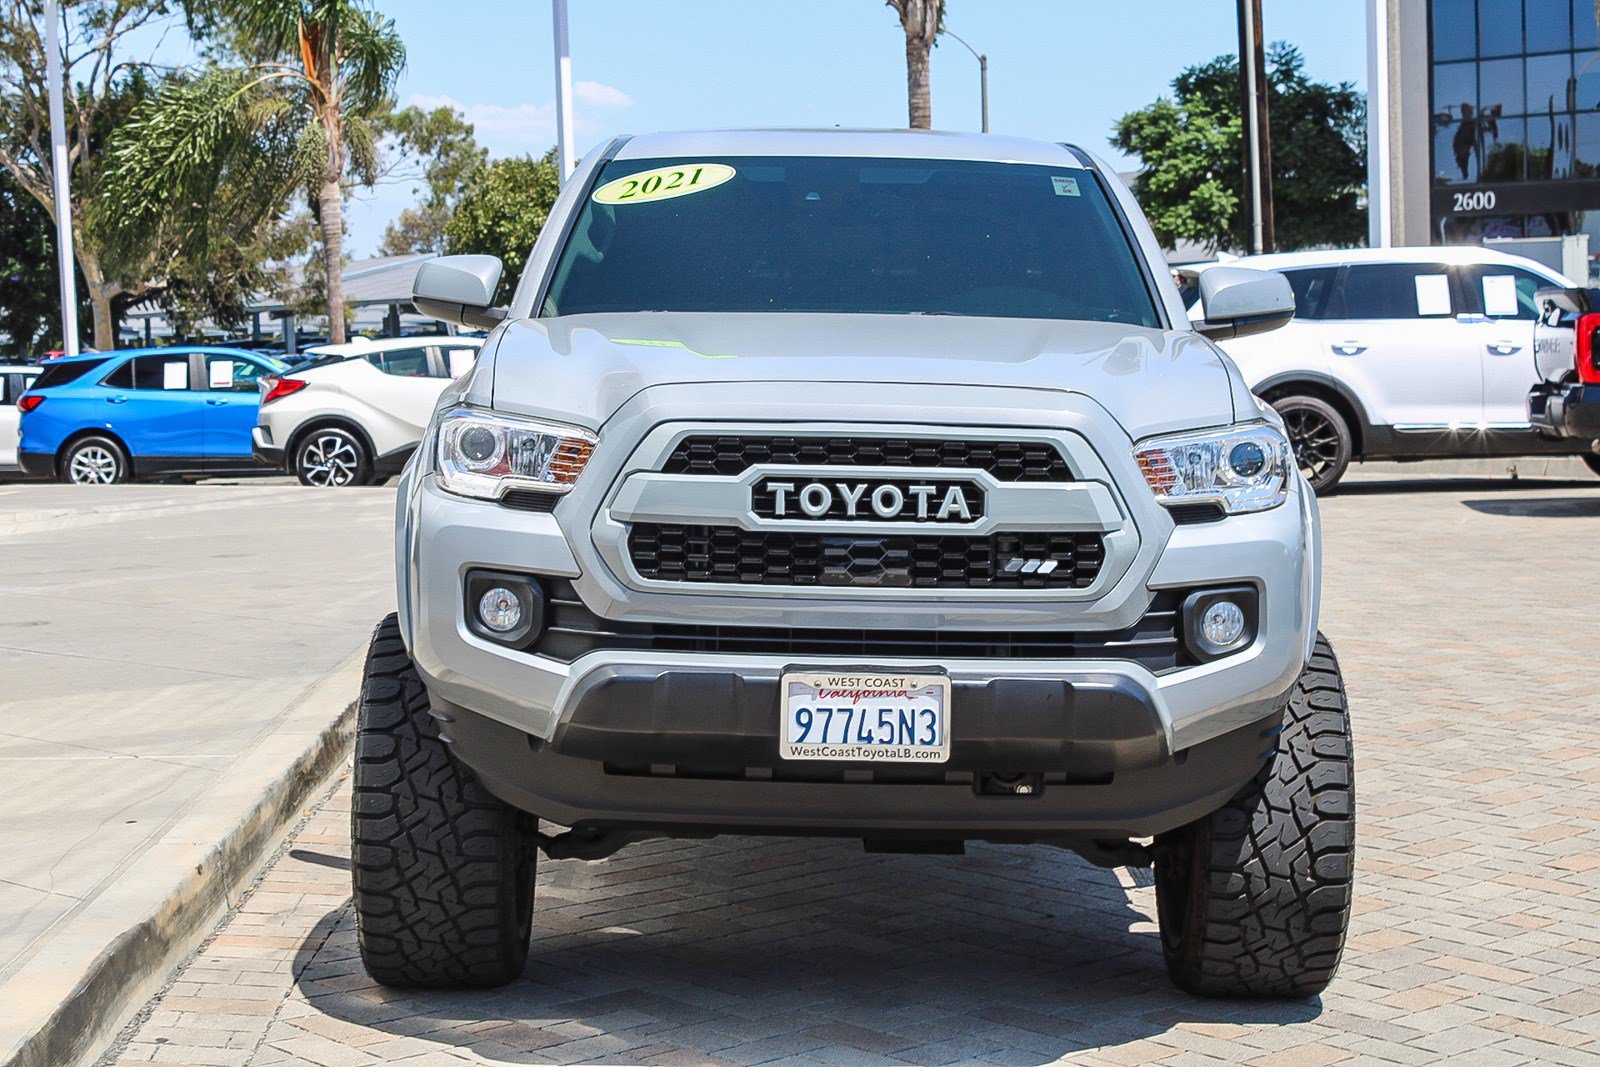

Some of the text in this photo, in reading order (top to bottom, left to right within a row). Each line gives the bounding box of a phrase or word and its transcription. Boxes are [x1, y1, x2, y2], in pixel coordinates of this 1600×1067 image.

[618, 168, 704, 200] 2021
[1453, 191, 1496, 211] 2600
[766, 482, 972, 520] TOYOTA
[828, 677, 905, 688] WEST COAST
[795, 708, 936, 746] 97745N3
[790, 746, 941, 760] WestCoastToyotaLB.com
